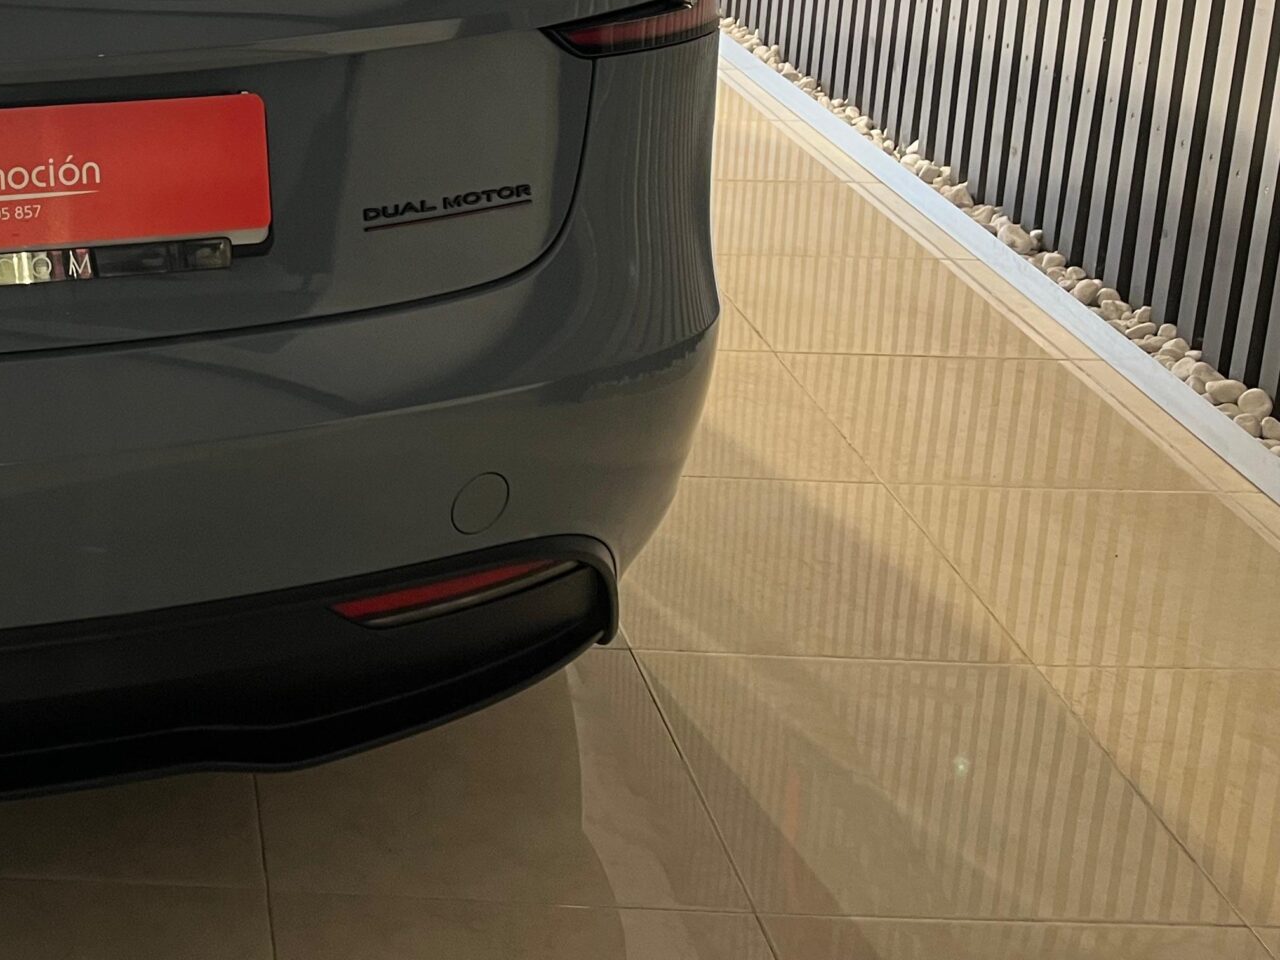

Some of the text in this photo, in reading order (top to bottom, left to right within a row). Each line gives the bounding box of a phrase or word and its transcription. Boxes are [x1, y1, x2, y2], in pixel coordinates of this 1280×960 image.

[14, 204, 41, 220] 857
[363, 184, 532, 222] DUAL MOTOR
